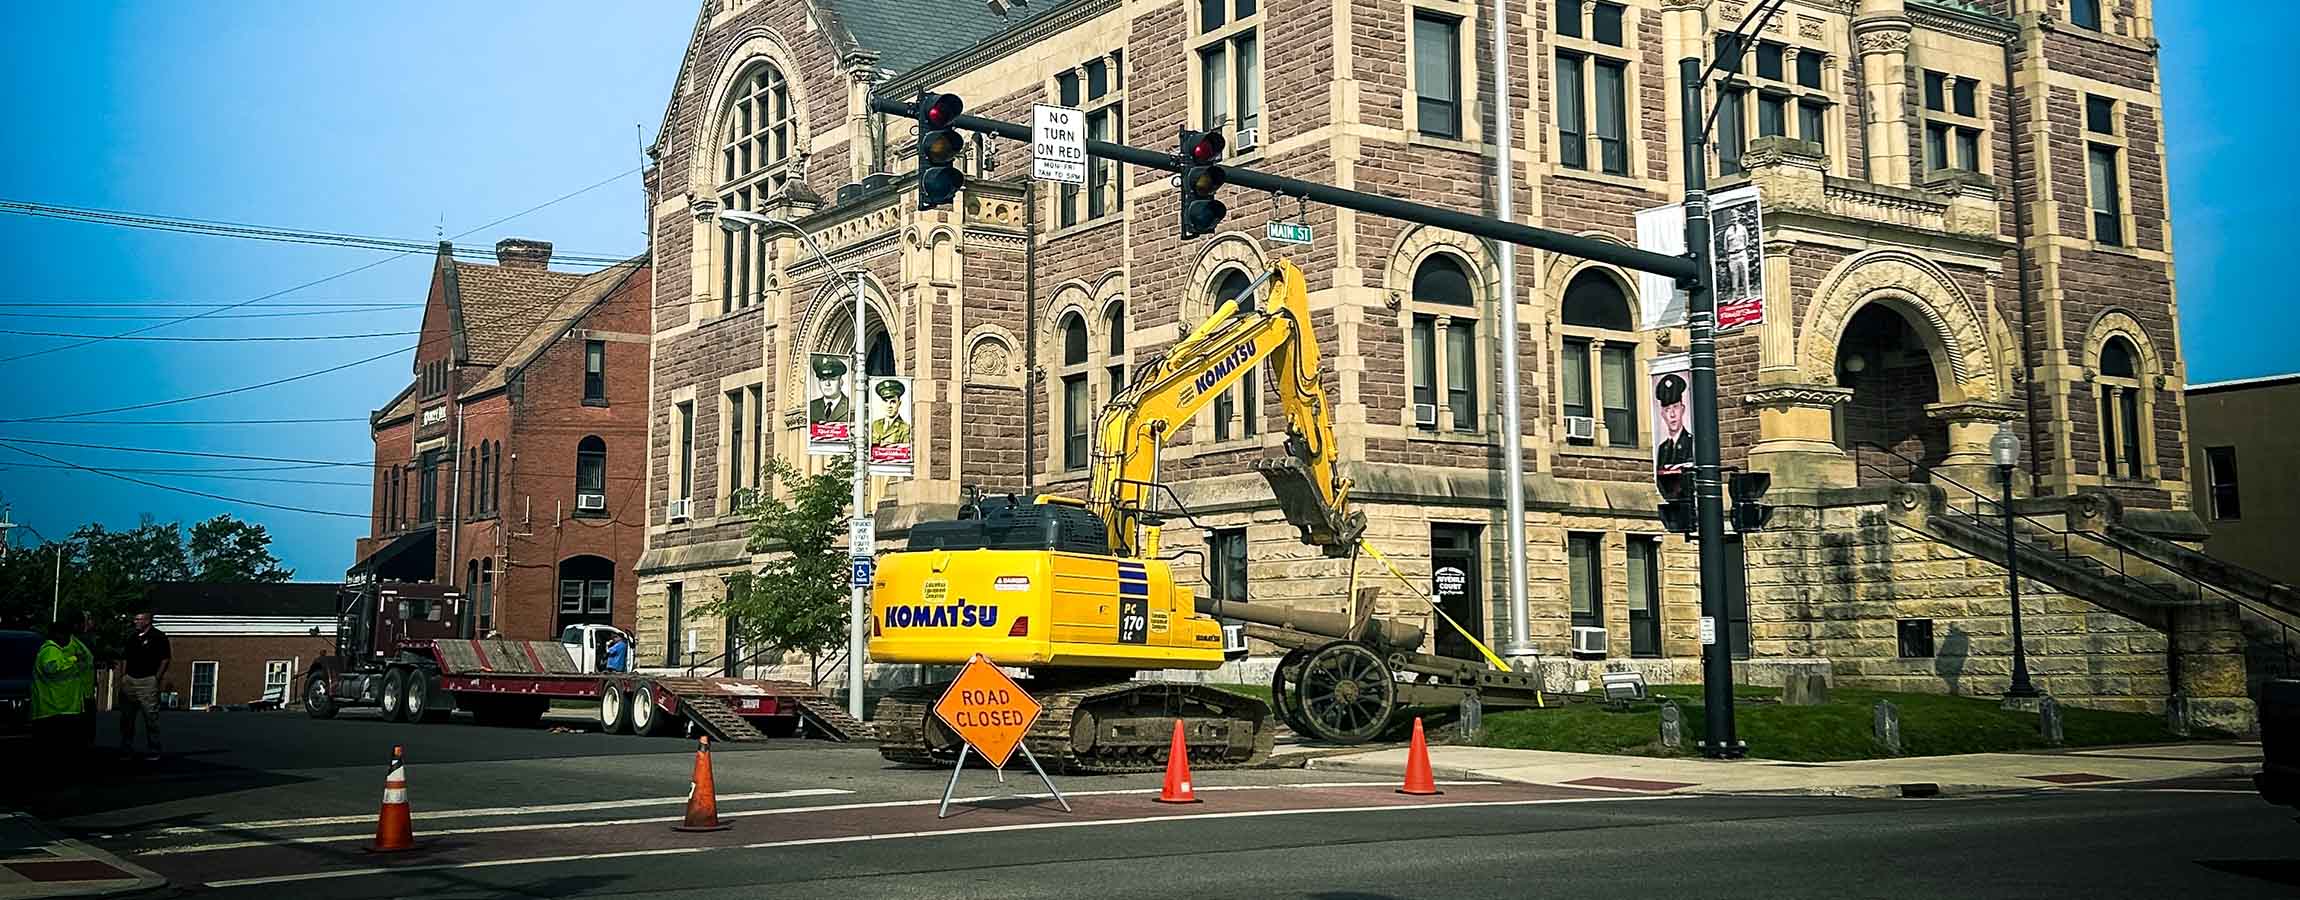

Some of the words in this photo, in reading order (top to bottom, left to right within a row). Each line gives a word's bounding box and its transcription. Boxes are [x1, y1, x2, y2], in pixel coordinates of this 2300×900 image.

[1049, 111, 1069, 125] NO
[1043, 127, 1074, 142] TURN
[1037, 143, 1053, 156] ON
[1059, 145, 1081, 159] RED
[1038, 169, 1052, 177] 7AM
[1043, 161, 1076, 171] MON-FRI
[1270, 223, 1294, 239] MAIN
[1297, 227, 1309, 240] ST
[1195, 338, 1256, 395] KOMATSU
[885, 598, 998, 629] KOMATSU
[1124, 603, 1136, 614] PC
[1123, 615, 1145, 631] 170
[1123, 632, 1133, 640] LC
[961, 689, 1010, 706] ROAD
[956, 710, 1024, 728] CLOSED
